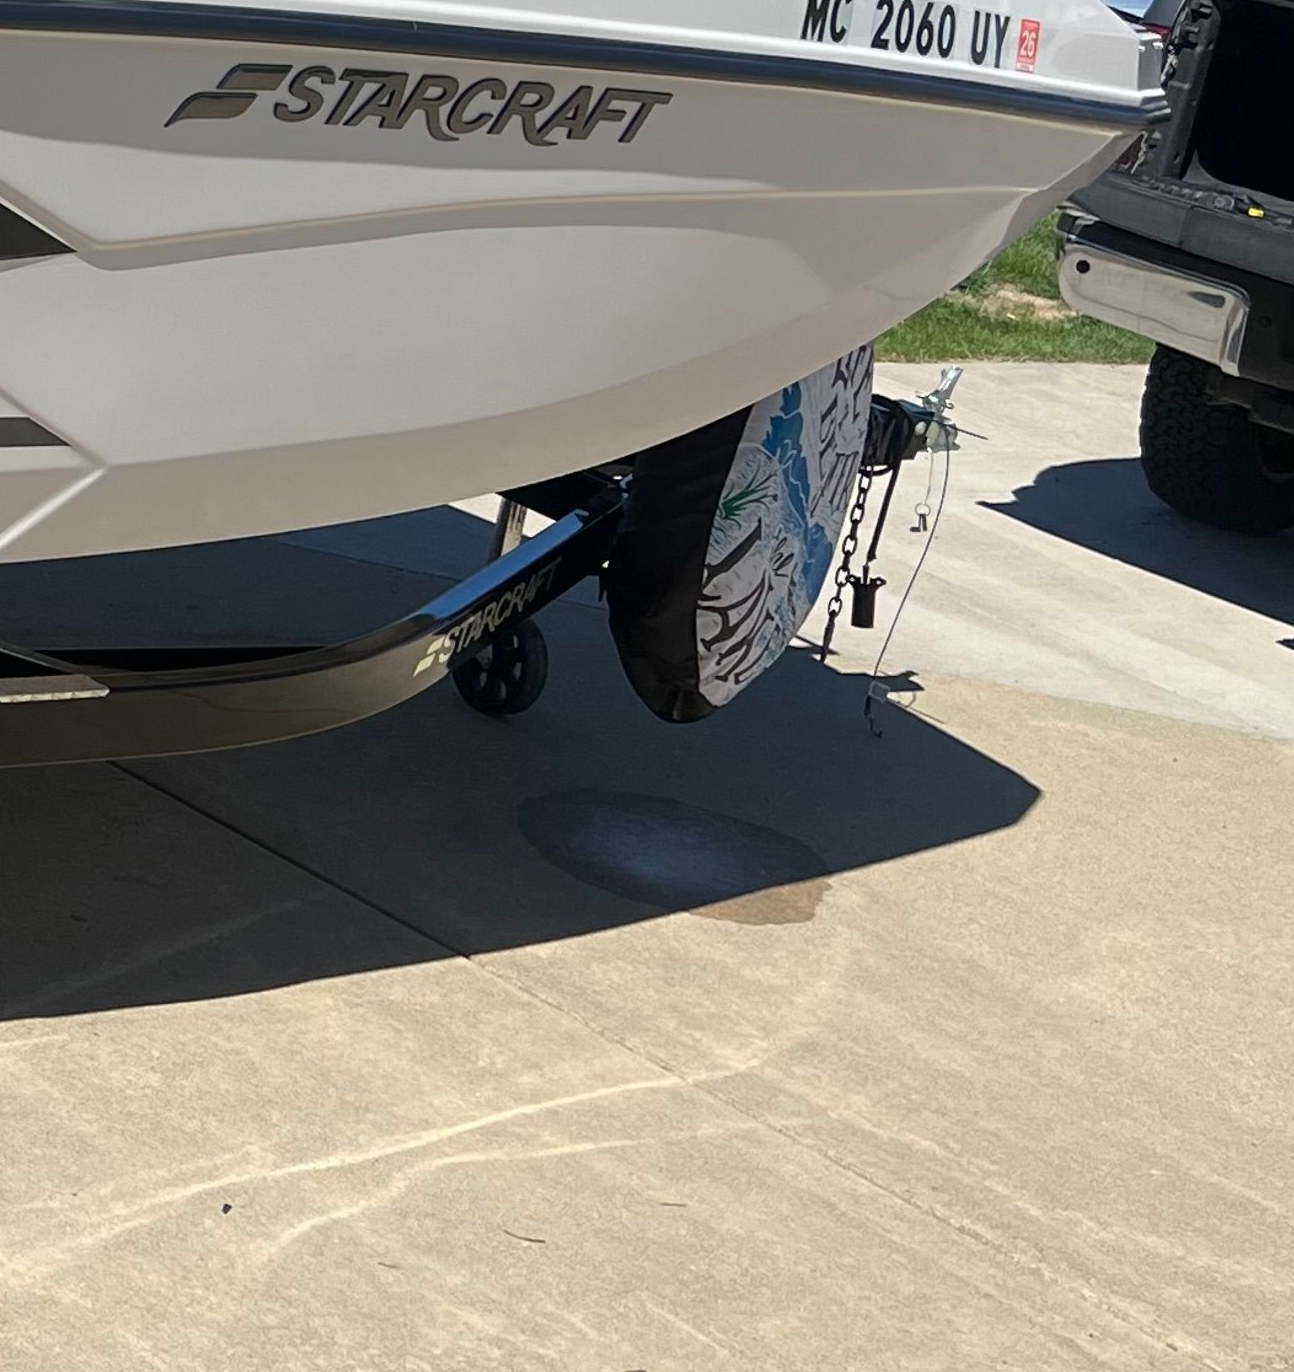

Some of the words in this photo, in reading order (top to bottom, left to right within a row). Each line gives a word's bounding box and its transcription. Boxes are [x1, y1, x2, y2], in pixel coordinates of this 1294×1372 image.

[970, 10, 1011, 69] UY
[1019, 30, 1037, 57] 26
[273, 65, 673, 146] STARCRAFT
[438, 556, 562, 663] STARCRAFT
